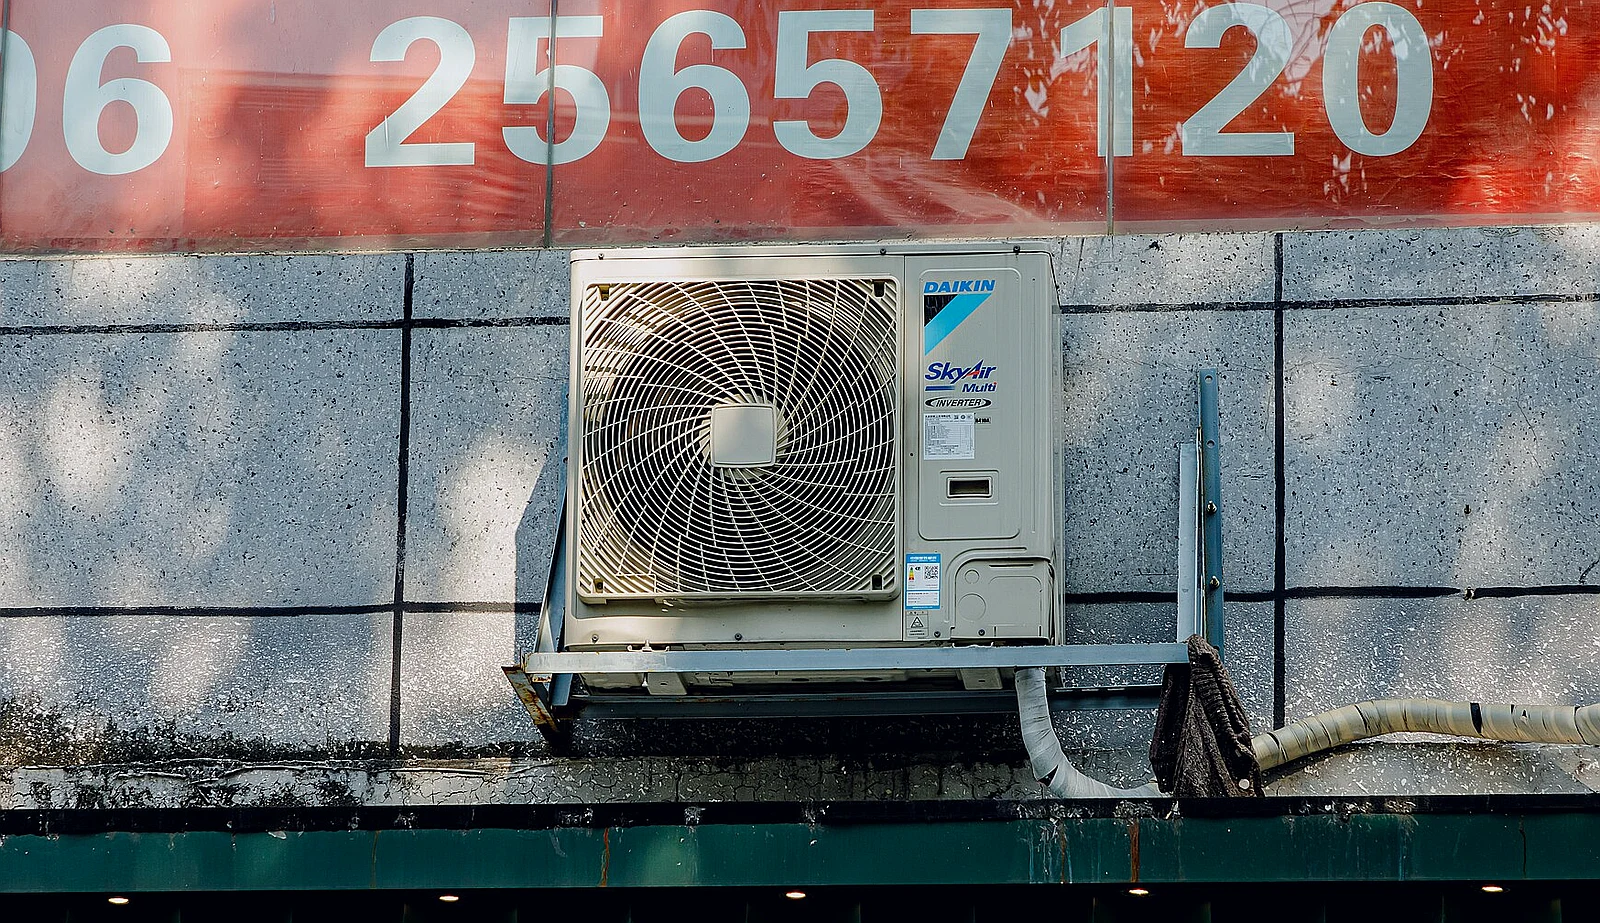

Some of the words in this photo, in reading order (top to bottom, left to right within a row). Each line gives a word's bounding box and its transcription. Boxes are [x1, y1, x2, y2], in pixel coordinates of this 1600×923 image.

[364, 1, 1435, 169] 25657120
[924, 280, 996, 293] DAIKIN
[925, 360, 997, 384] SkyAir
[962, 382, 997, 392] Multi
[936, 399, 982, 407] INVERTER
